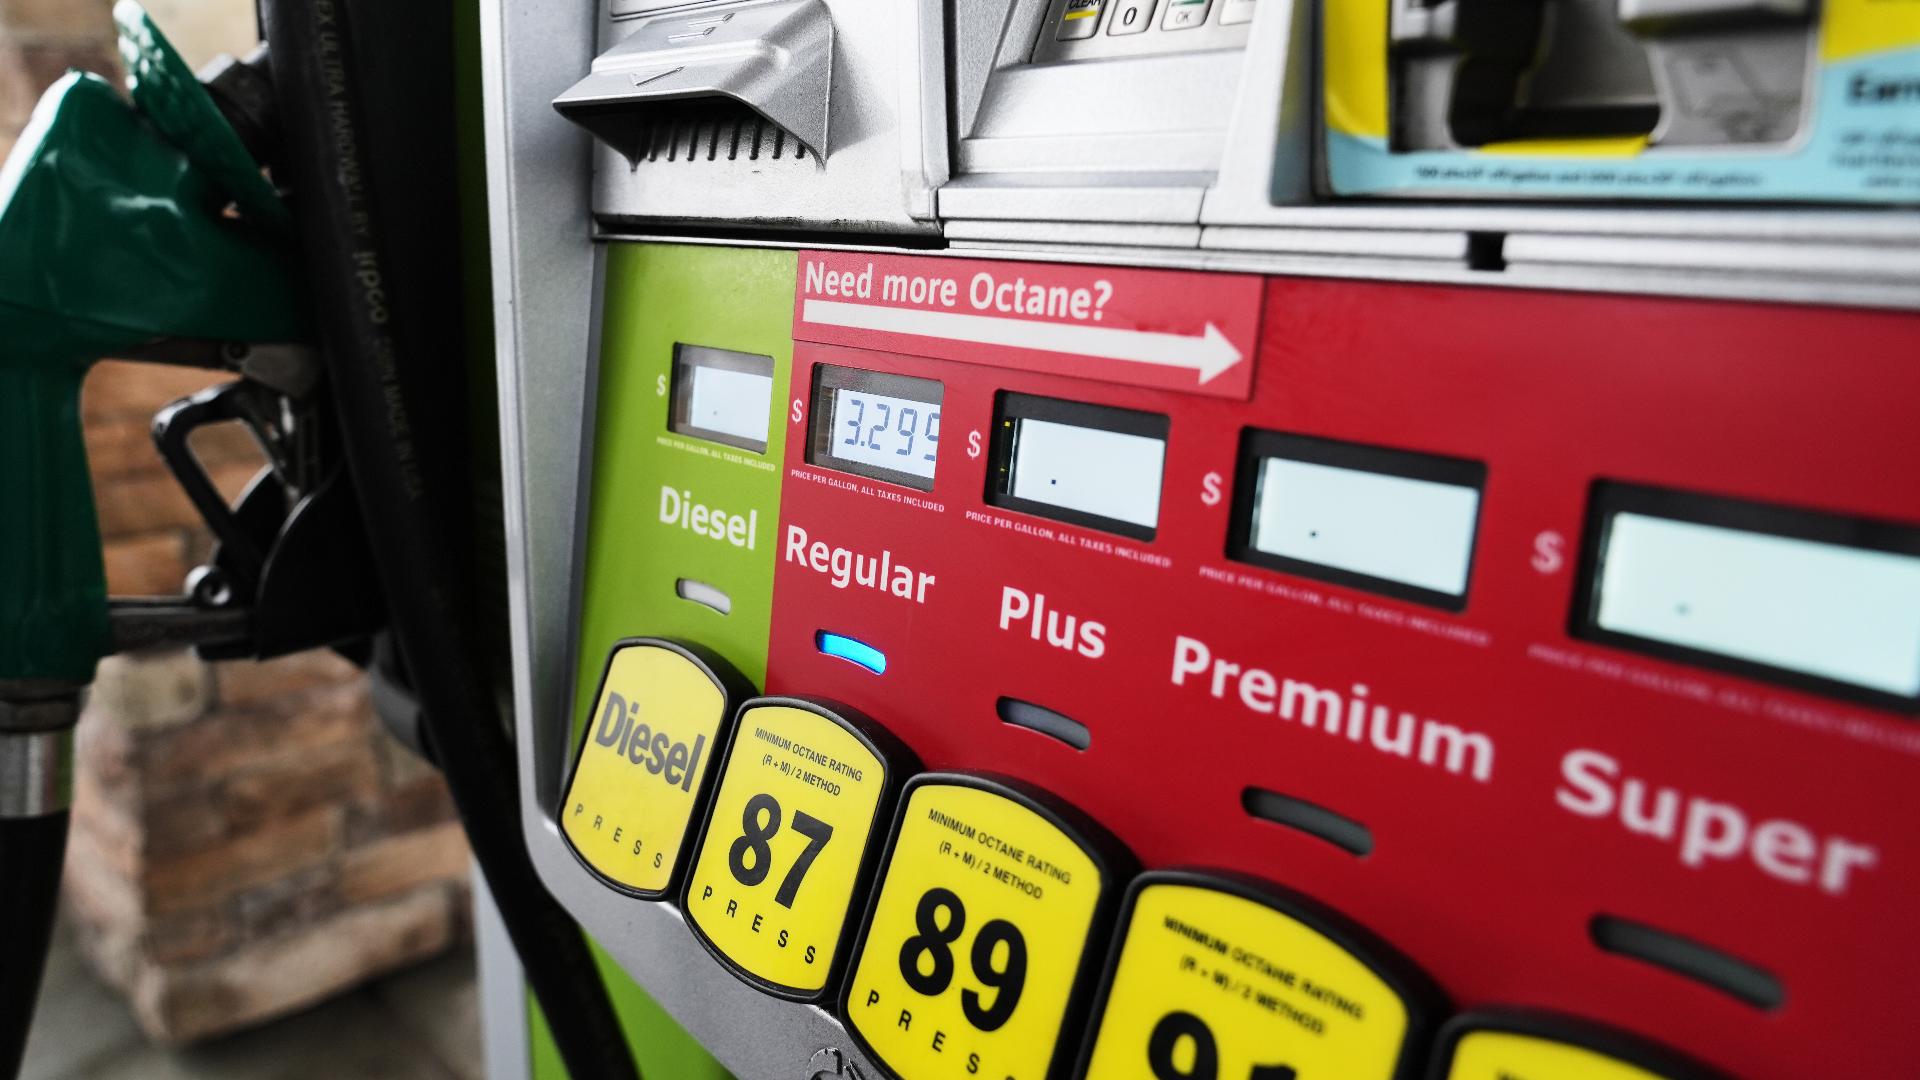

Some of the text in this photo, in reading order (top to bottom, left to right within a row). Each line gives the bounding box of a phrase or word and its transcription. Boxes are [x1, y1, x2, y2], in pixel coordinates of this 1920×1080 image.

[804, 261, 1113, 321] Need more Octane?
[656, 374, 666, 397] $
[791, 398, 803, 424] $
[966, 429, 981, 460] $
[659, 485, 757, 550] Diesel
[791, 469, 945, 513] PRICE PER GALLON, ALL TAXES INCLUDED
[1200, 471, 1223, 506] $
[785, 524, 936, 604] Regular
[965, 510, 992, 525] PRICE
[994, 518, 1012, 529] PER
[1057, 533, 1076, 545] ALL
[1080, 537, 1112, 554] TAXES
[1114, 546, 1172, 568] INCLUDED
[999, 585, 1107, 660] Plus
[1171, 635, 1495, 782] Premium
[595, 691, 706, 793] Diesel
[755, 727, 863, 782] MINIMUM OCTANE RATING
[802, 773, 841, 797] METHOD
[728, 793, 834, 910] 87
[928, 808, 1072, 885] MINIMUM OCTANE RATING
[1555, 748, 1880, 893] Super
[993, 867, 1043, 900] METHOD
[899, 887, 1028, 1032] 89
[1147, 1009, 1297, 1080] 9
